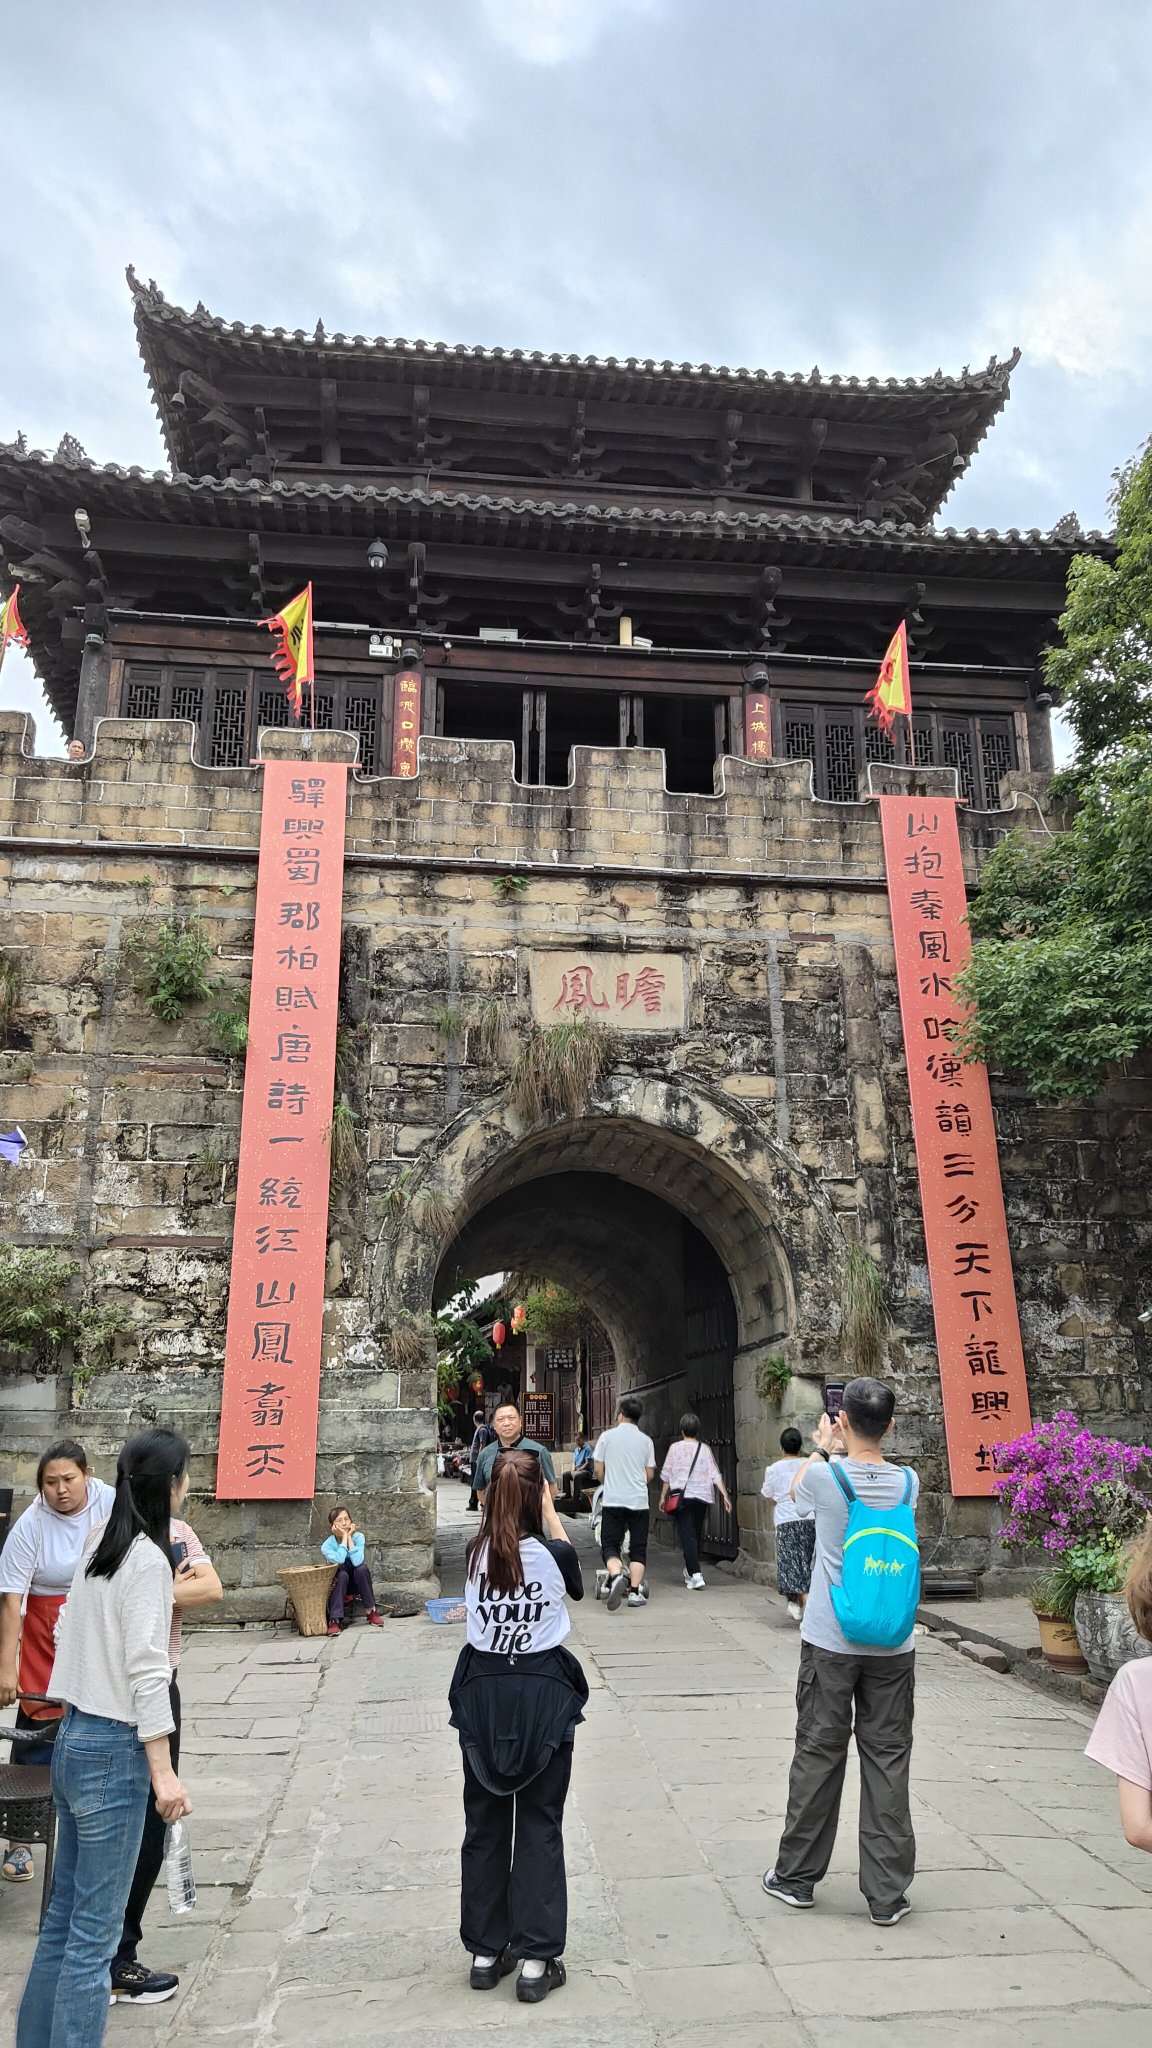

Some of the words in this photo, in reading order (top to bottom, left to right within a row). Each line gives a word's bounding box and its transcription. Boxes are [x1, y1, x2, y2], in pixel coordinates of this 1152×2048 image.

[750, 702, 768, 755] 上城樓
[478, 1572, 544, 1603] love
[475, 1600, 551, 1635] your
[489, 1623, 533, 1656] life
